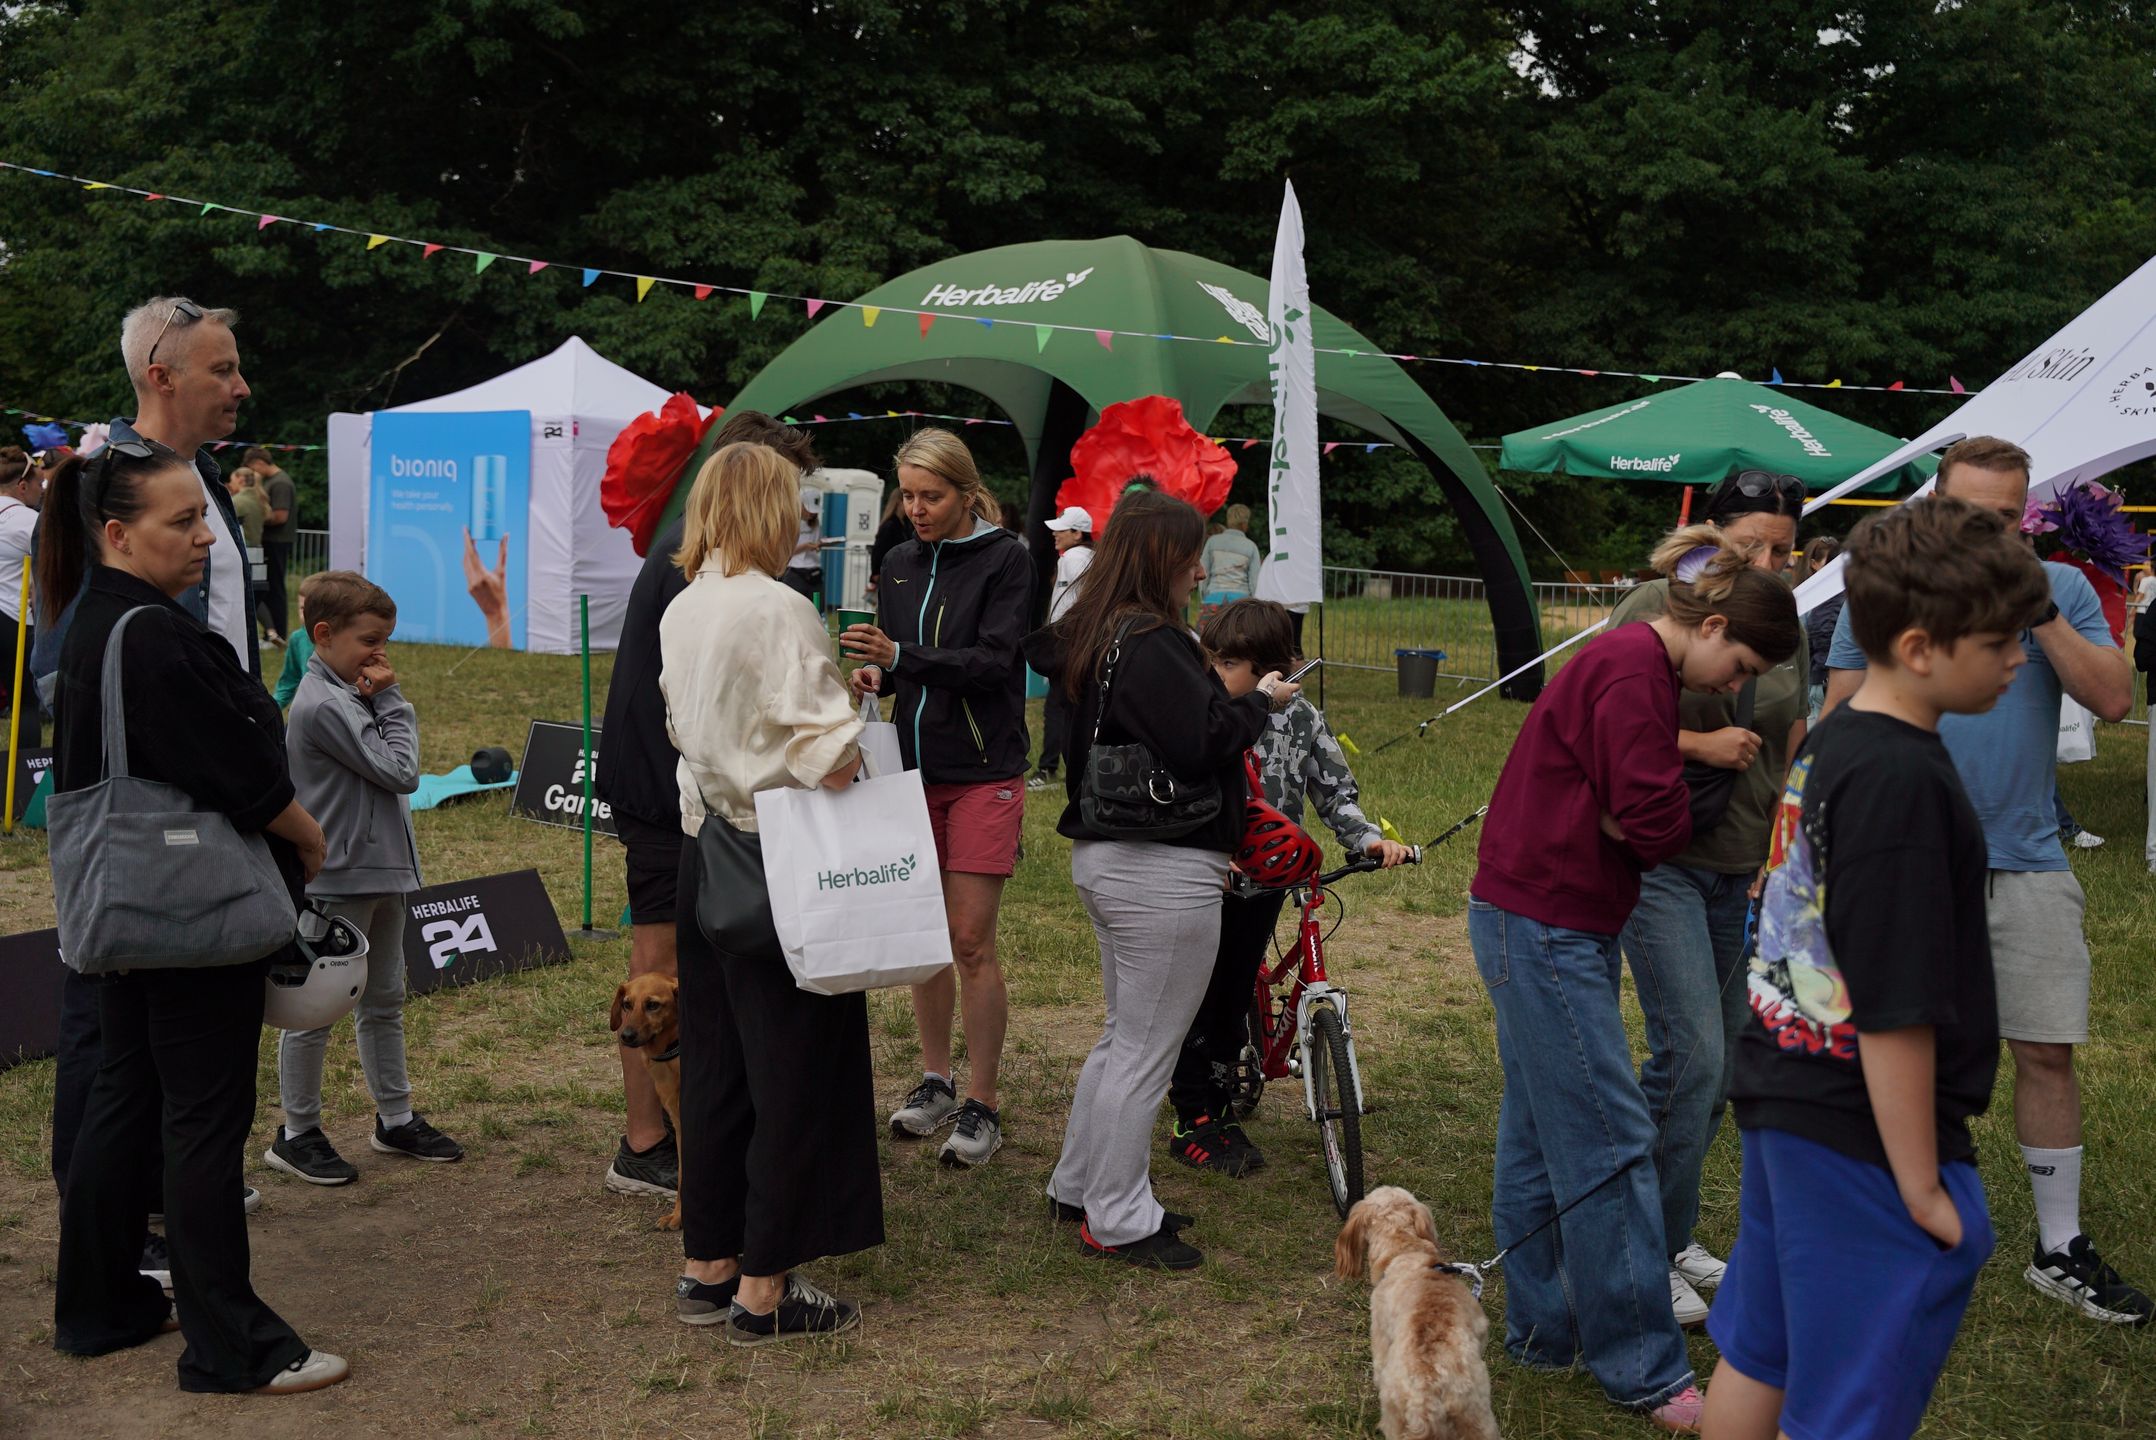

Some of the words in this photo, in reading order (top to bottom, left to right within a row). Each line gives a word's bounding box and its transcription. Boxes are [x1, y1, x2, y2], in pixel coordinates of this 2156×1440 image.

[920, 279, 1065, 306] Herbalife
[391, 454, 457, 482] bioniq
[1610, 456, 1673, 472] Herbalife
[817, 863, 911, 891] Herbalife
[411, 895, 481, 919] HERBALIFE
[421, 912, 498, 969] 24
